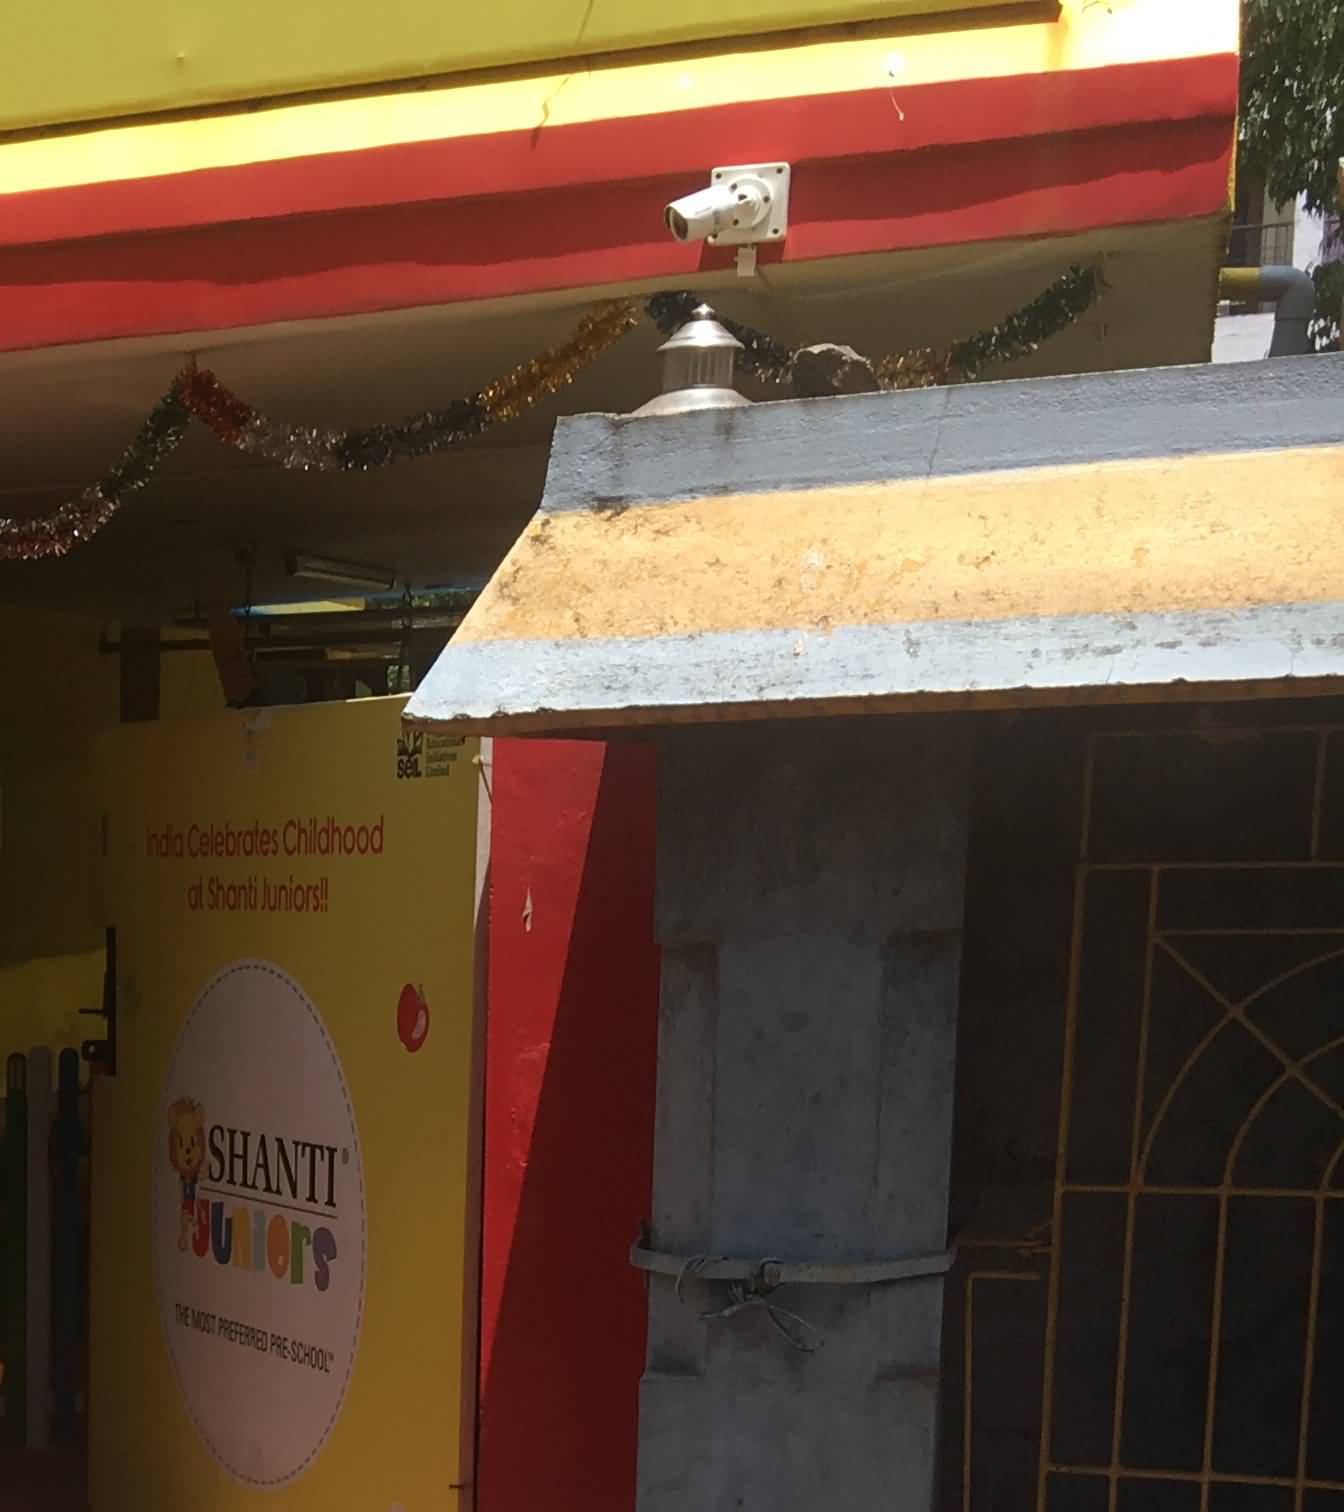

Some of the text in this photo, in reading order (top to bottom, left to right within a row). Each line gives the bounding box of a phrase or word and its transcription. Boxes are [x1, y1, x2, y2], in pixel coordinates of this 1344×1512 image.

[145, 814, 384, 858] India Celebrates Childhood
[188, 874, 328, 913] at Shanti Juniors!!
[208, 1125, 338, 1208] SHANTI
[175, 1303, 190, 1327] THE
[192, 1309, 216, 1335] MOST
[218, 1317, 268, 1352] PREFERRED
